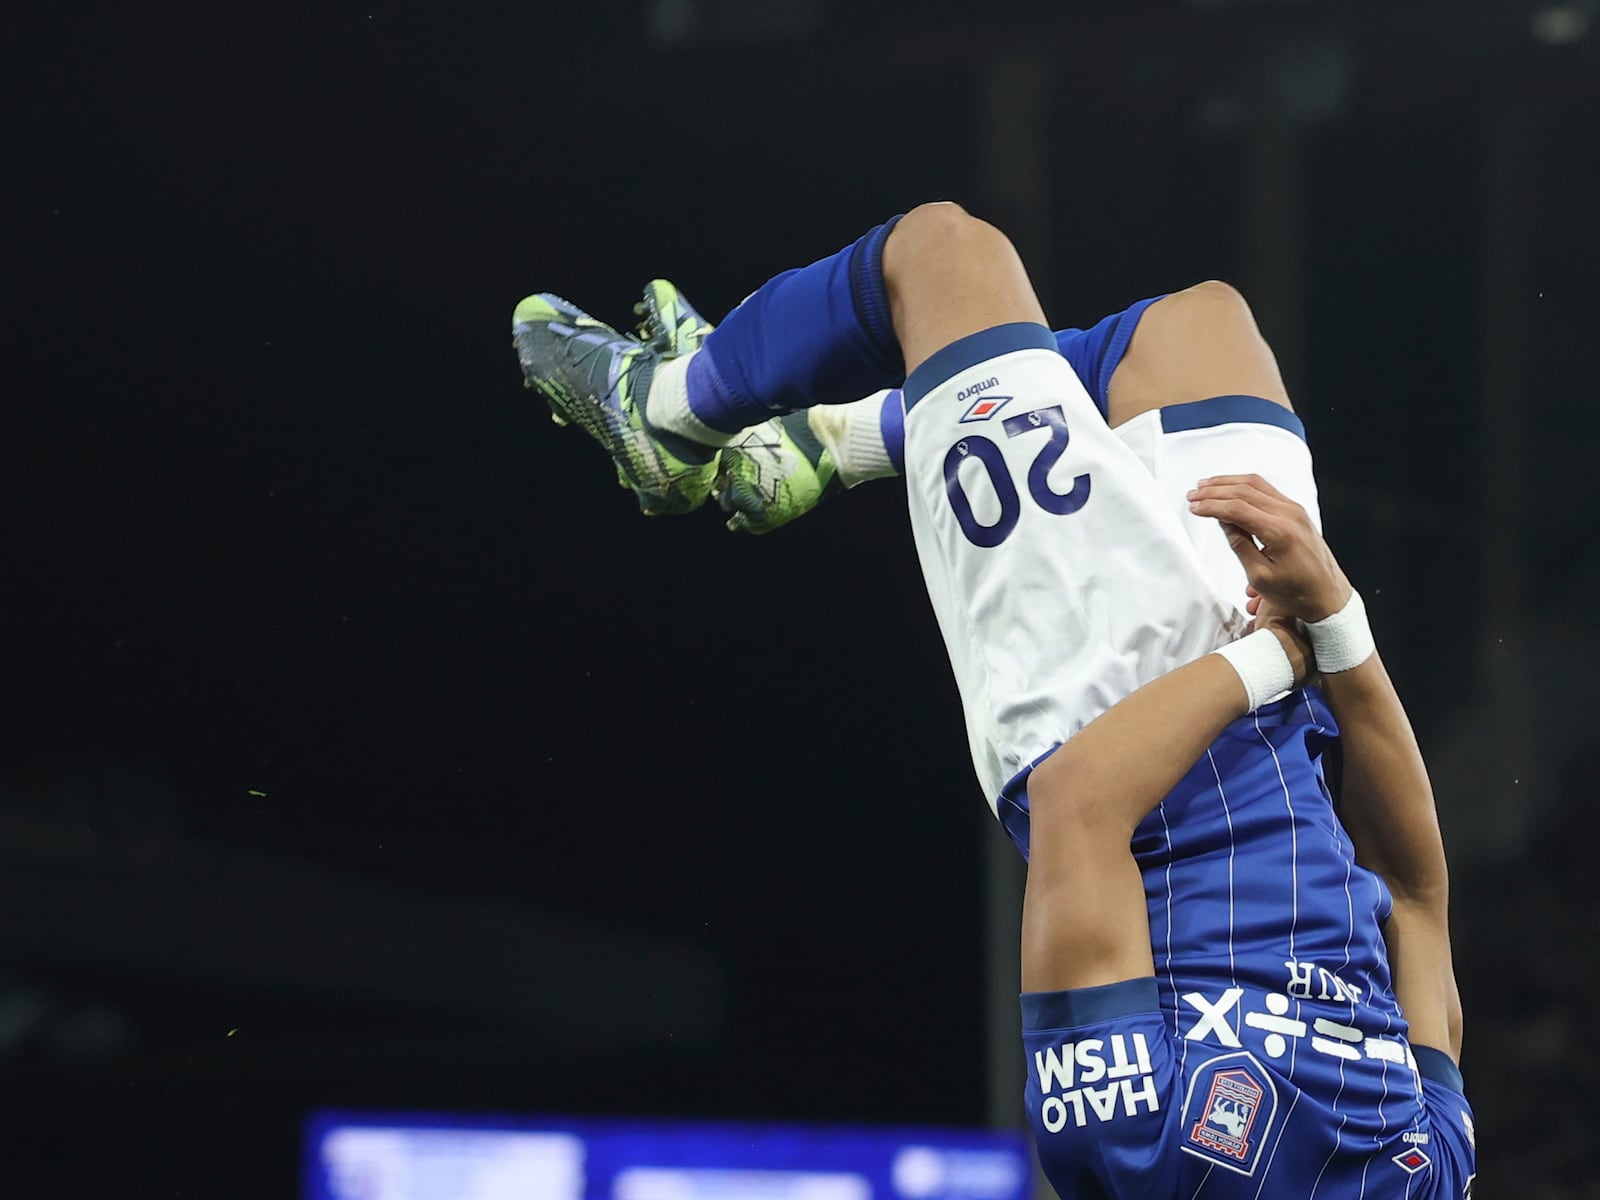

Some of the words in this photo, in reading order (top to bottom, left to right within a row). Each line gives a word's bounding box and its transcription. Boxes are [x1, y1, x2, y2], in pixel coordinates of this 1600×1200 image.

[957, 377, 1000, 401] umbro
[943, 405, 1091, 548] 20
[1035, 1033, 1152, 1094] ITSM
[1042, 1075, 1160, 1133] HALO
[1402, 1132, 1429, 1144] umbro
